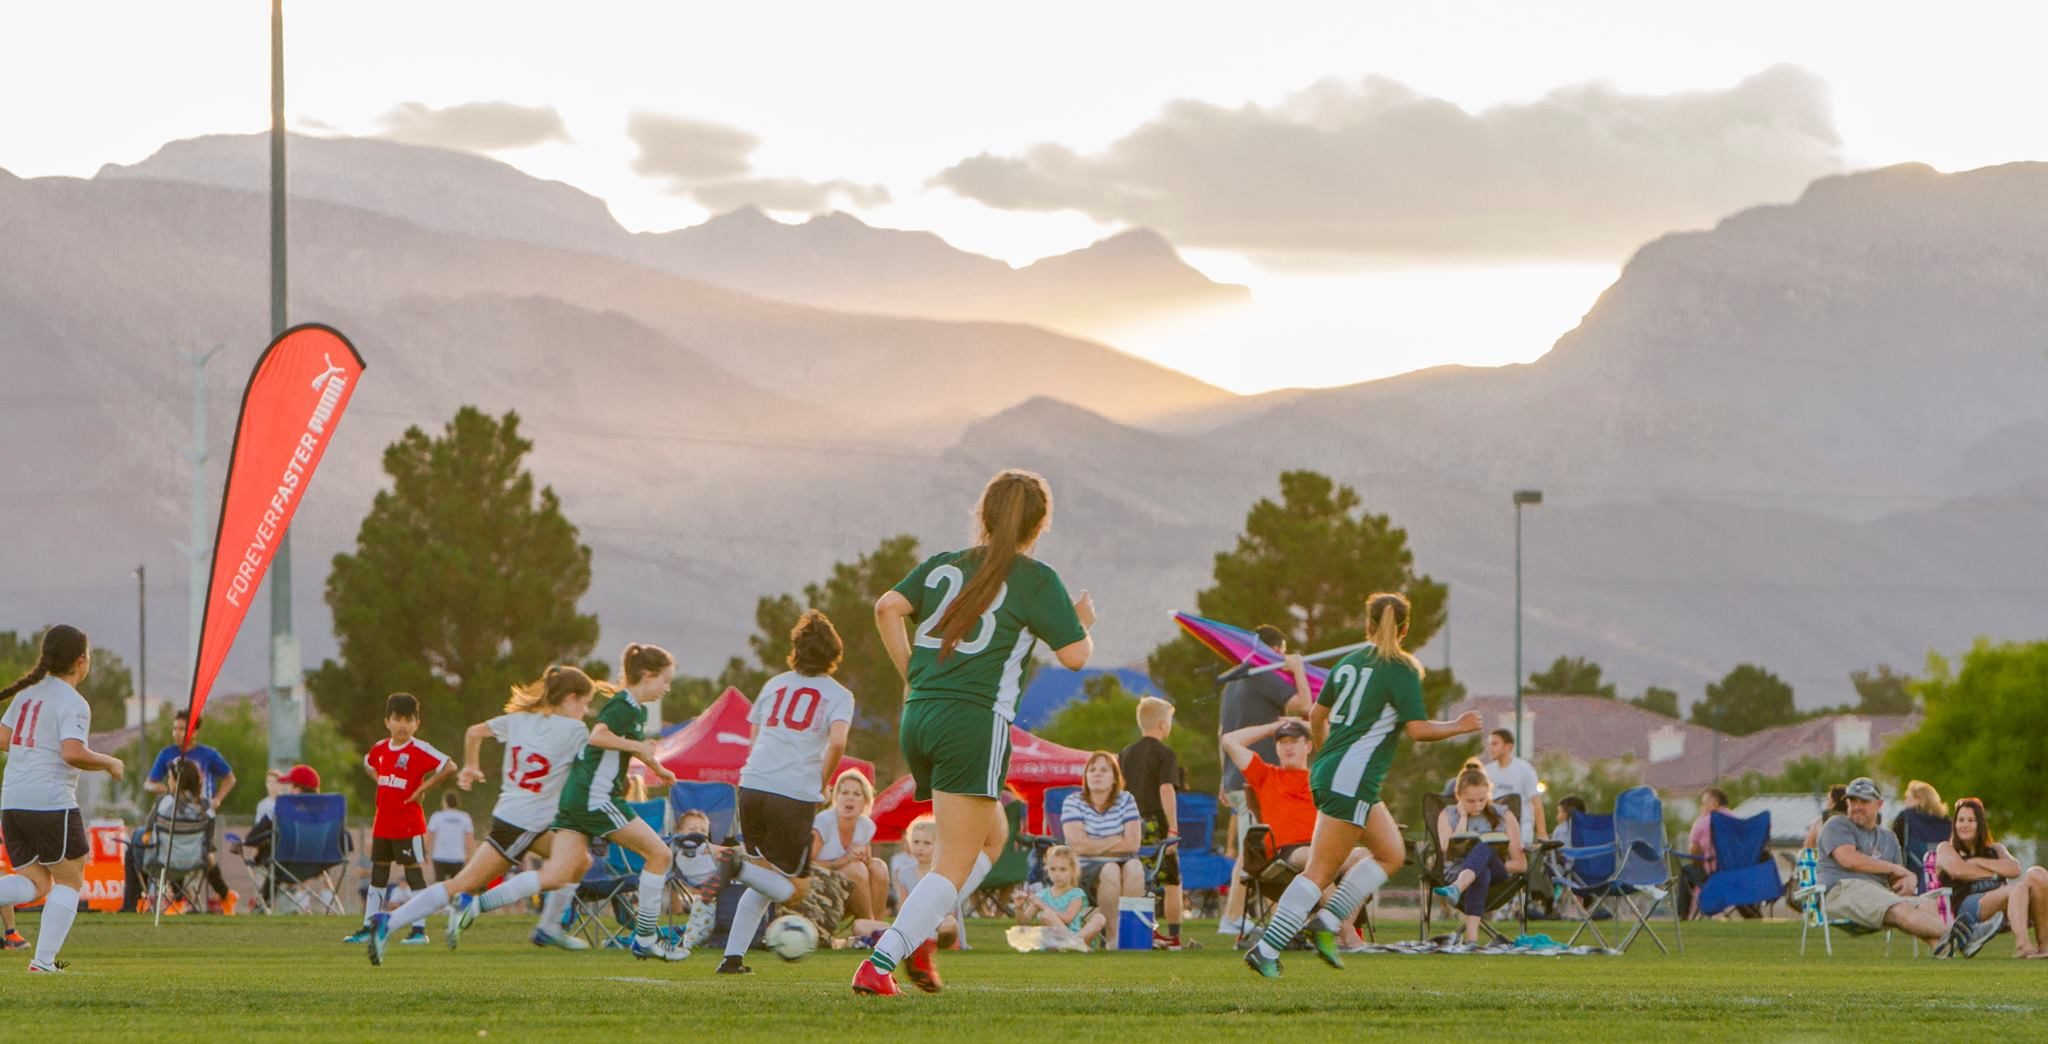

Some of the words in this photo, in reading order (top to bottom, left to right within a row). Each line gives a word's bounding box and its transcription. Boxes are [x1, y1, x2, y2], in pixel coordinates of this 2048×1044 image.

[308, 374, 346, 435] PUMA
[766, 686, 821, 732] 10
[1328, 664, 1374, 727] 21
[12, 699, 43, 748] 11
[508, 745, 552, 793] 12
